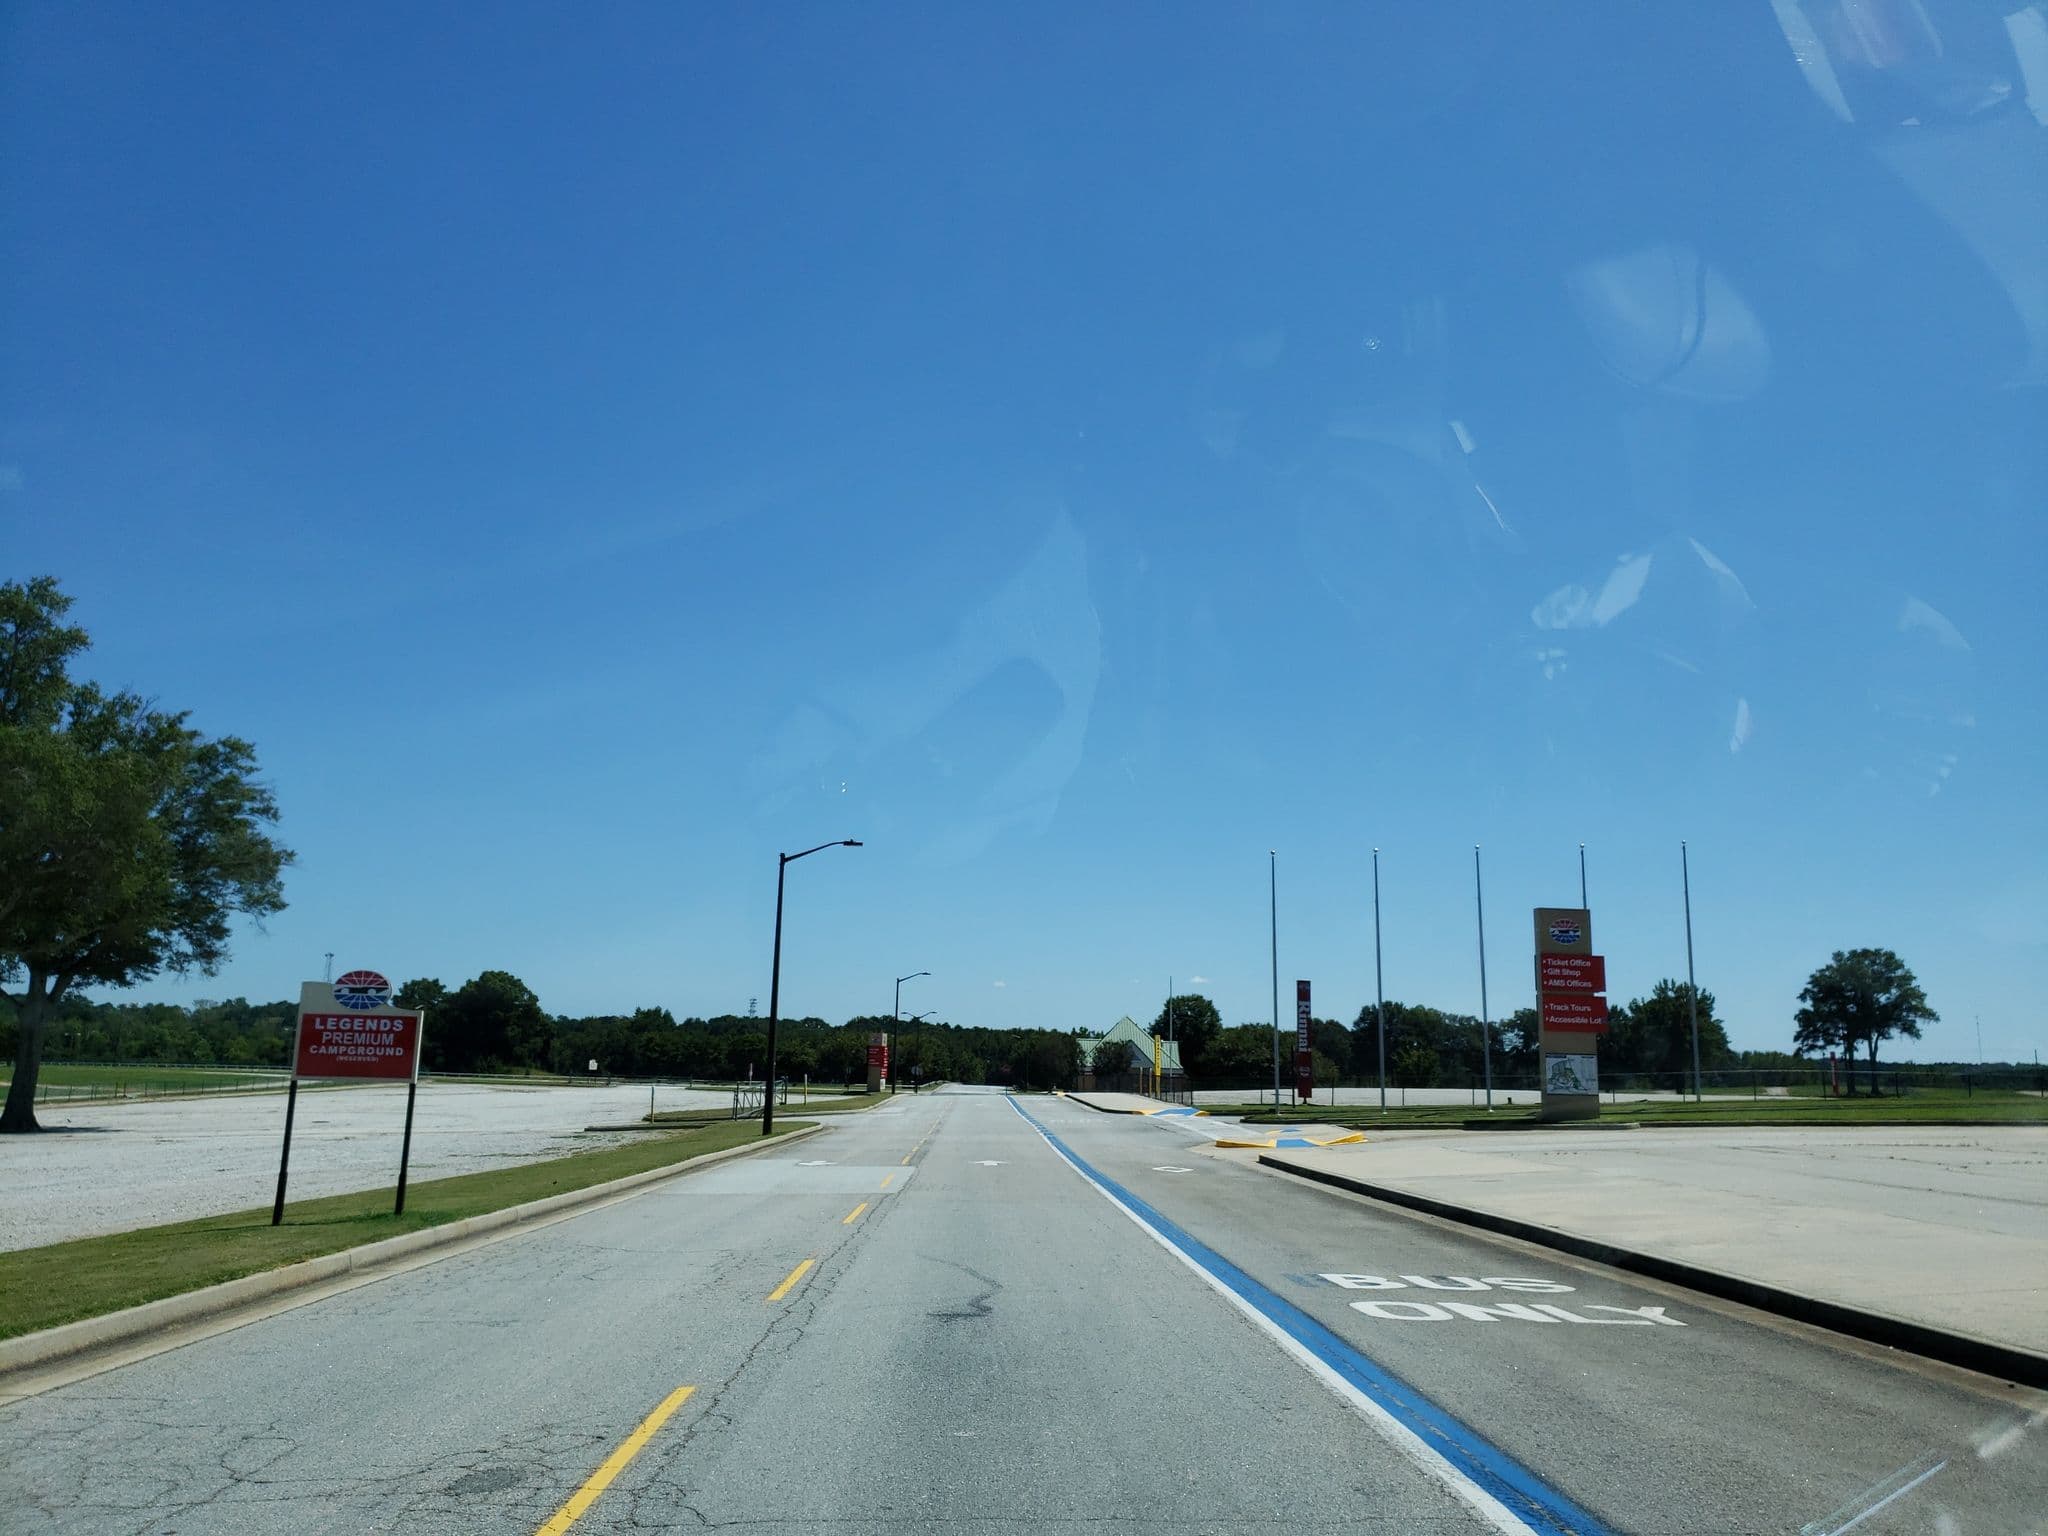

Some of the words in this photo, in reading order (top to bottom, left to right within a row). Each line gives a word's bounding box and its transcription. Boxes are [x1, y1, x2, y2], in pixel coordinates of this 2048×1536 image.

[1547, 958, 1569, 967] Ticket
[1570, 959, 1591, 967] Office
[1548, 968, 1561, 976] Gift
[1561, 968, 1581, 978] Shop
[1548, 979, 1566, 987] AMS
[1567, 979, 1592, 988] Offices
[1549, 1003, 1569, 1011] Track
[1570, 1003, 1592, 1012] Tours
[315, 1018, 403, 1031] LEGENDS
[1549, 1015, 1589, 1024] Accessible
[1589, 1016, 1602, 1025] Lot
[1298, 1001, 1311, 1052] Rinnai
[322, 1032, 394, 1045] PREMIUM
[310, 1045, 403, 1055] CAMPGROUND
[1318, 1273, 1577, 1293] BUS
[1348, 1300, 1689, 1327] ONLY
